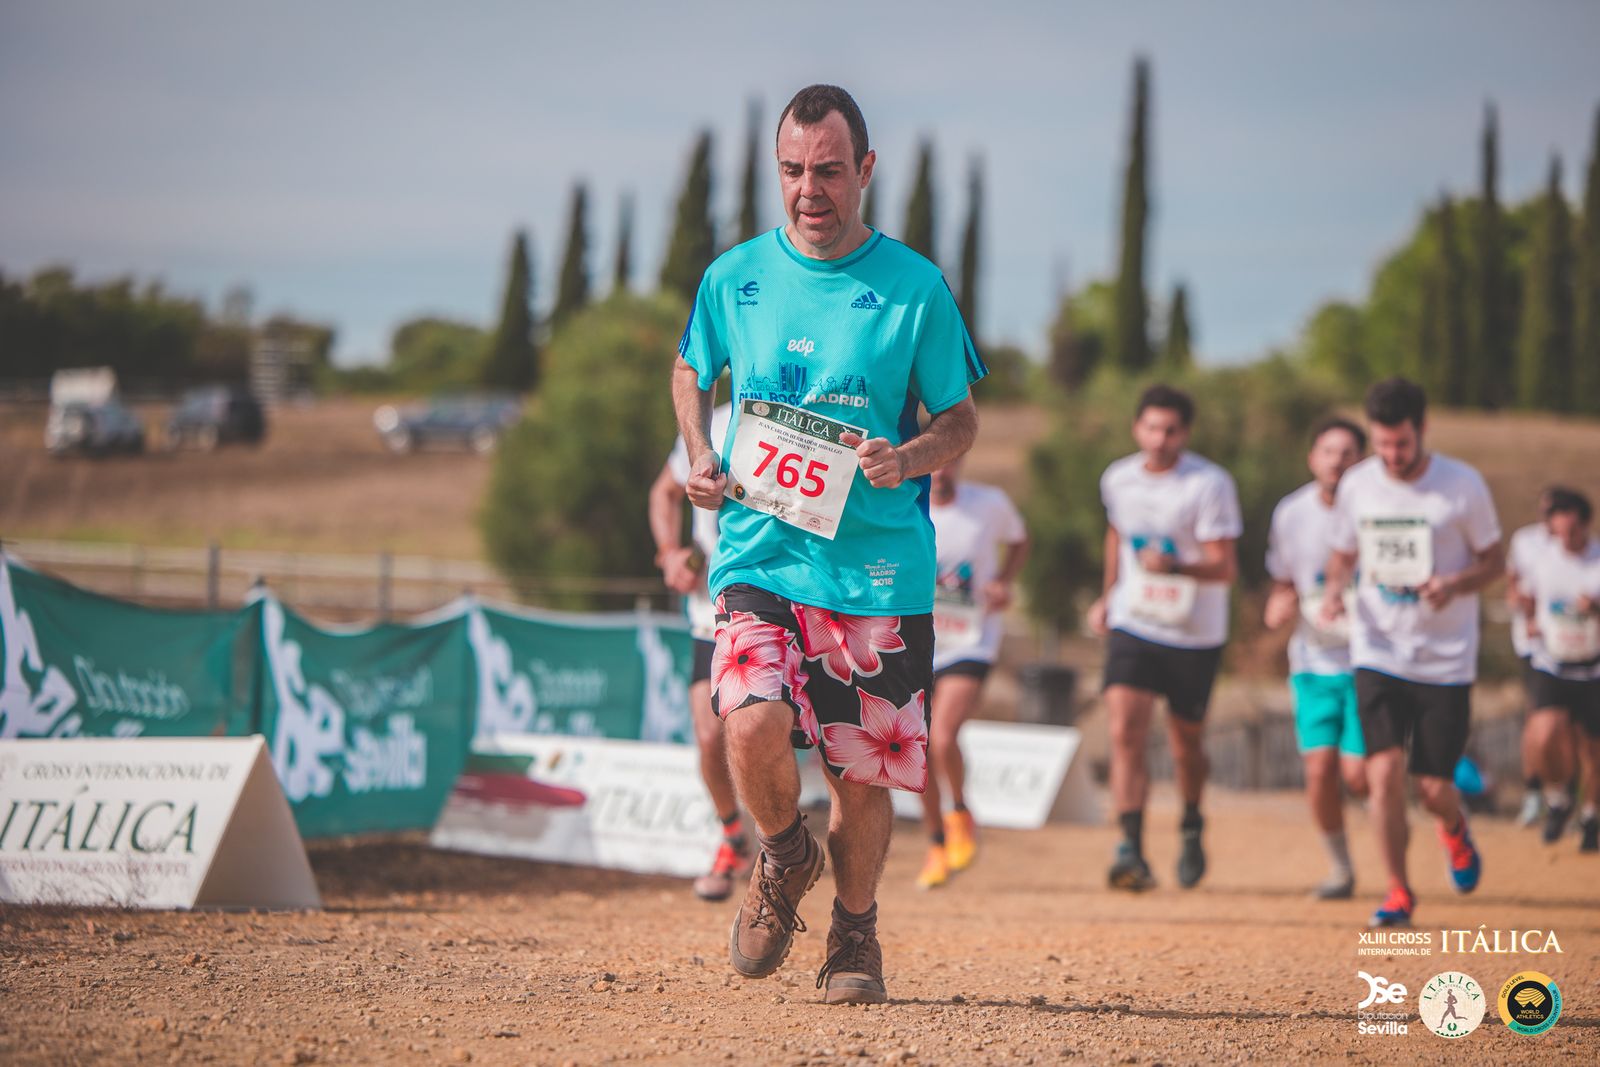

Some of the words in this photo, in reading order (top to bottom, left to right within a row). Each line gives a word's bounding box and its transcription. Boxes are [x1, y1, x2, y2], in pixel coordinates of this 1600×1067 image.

[851, 300, 882, 310] adidas
[787, 337, 815, 357] edp
[804, 394, 869, 408] MADRID!
[776, 408, 830, 437] ITÁLICA
[753, 440, 829, 498] 765
[873, 578, 894, 587] 2018
[23, 762, 72, 782] CROSS
[75, 762, 202, 782] INTERNACIONAL
[207, 762, 231, 782] DE
[0, 785, 198, 853] ITÁLICA
